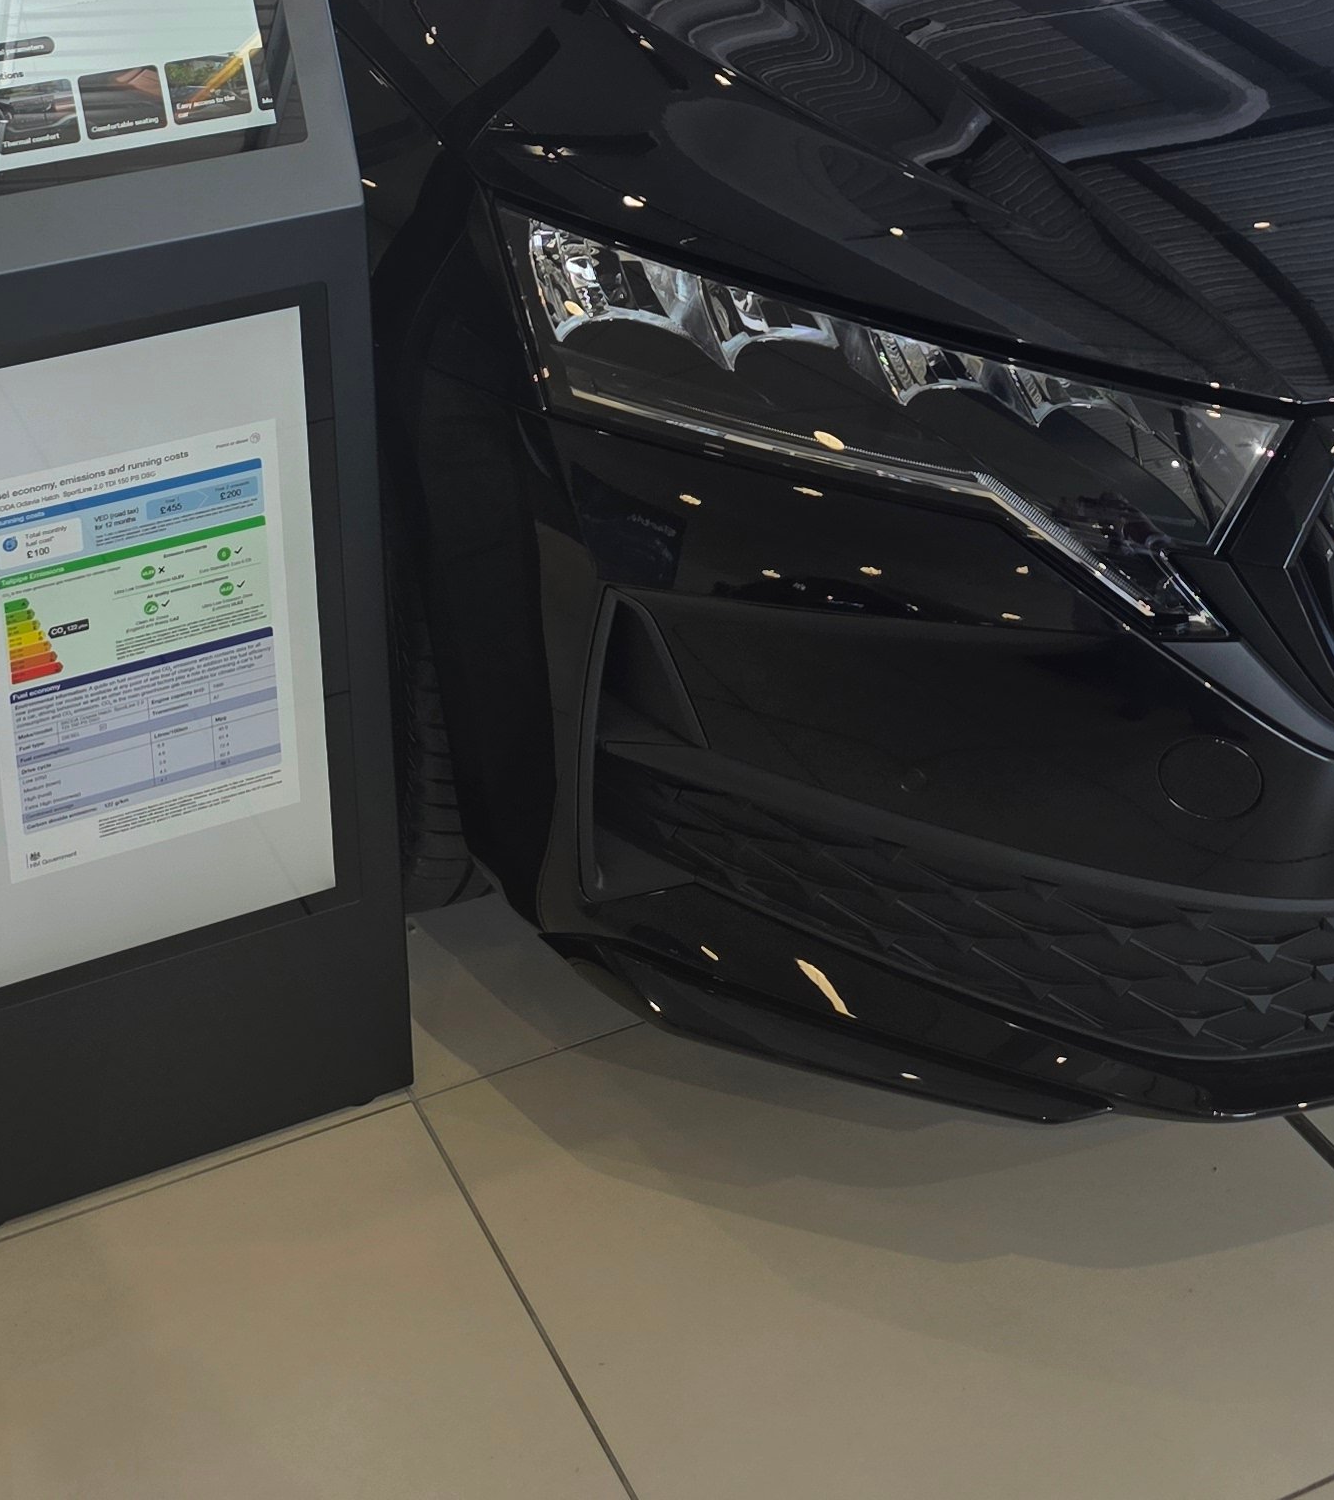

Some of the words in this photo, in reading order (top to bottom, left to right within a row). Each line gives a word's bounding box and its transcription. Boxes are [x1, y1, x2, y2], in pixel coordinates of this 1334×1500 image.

[175, 100, 192, 111] Easy
[215, 95, 223, 104] to
[223, 93, 236, 102] the
[90, 119, 134, 134] Comfortable
[134, 114, 160, 127] seating
[1, 136, 31, 148] Thermal
[31, 131, 60, 143] comfort
[11, 479, 57, 499] economy,
[58, 468, 106, 487] emissions
[107, 463, 125, 476] and
[127, 455, 162, 473] running
[163, 449, 189, 463] costs
[15, 496, 40, 509] Octavia
[41, 492, 59, 503] Hatch
[62, 484, 92, 499] SportLine
[93, 482, 104, 491] 2.0
[104, 479, 116, 488] TDI
[116, 476, 129, 486] 150
[129, 474, 139, 483] PS
[140, 470, 157, 480] DSG
[219, 487, 242, 500] £200
[24, 509, 45, 521] costs
[93, 513, 108, 523] VED
[109, 509, 126, 520] (road
[126, 506, 139, 516] tax)
[159, 501, 183, 515] £455
[94, 523, 102, 531] for
[113, 515, 136, 526] months
[24, 530, 41, 540] Total
[42, 524, 68, 537] monthly
[25, 539, 38, 548] fuel
[26, 545, 50, 559] £100
[1, 574, 27, 587] Tailpipe
[29, 565, 65, 580] Emissions
[12, 690, 28, 701] Fuel
[28, 682, 61, 698] economy
[20, 766, 36, 775] Drive
[36, 762, 51, 772] cycle
[29, 860, 41, 868] HM
[41, 850, 77, 865] Government
